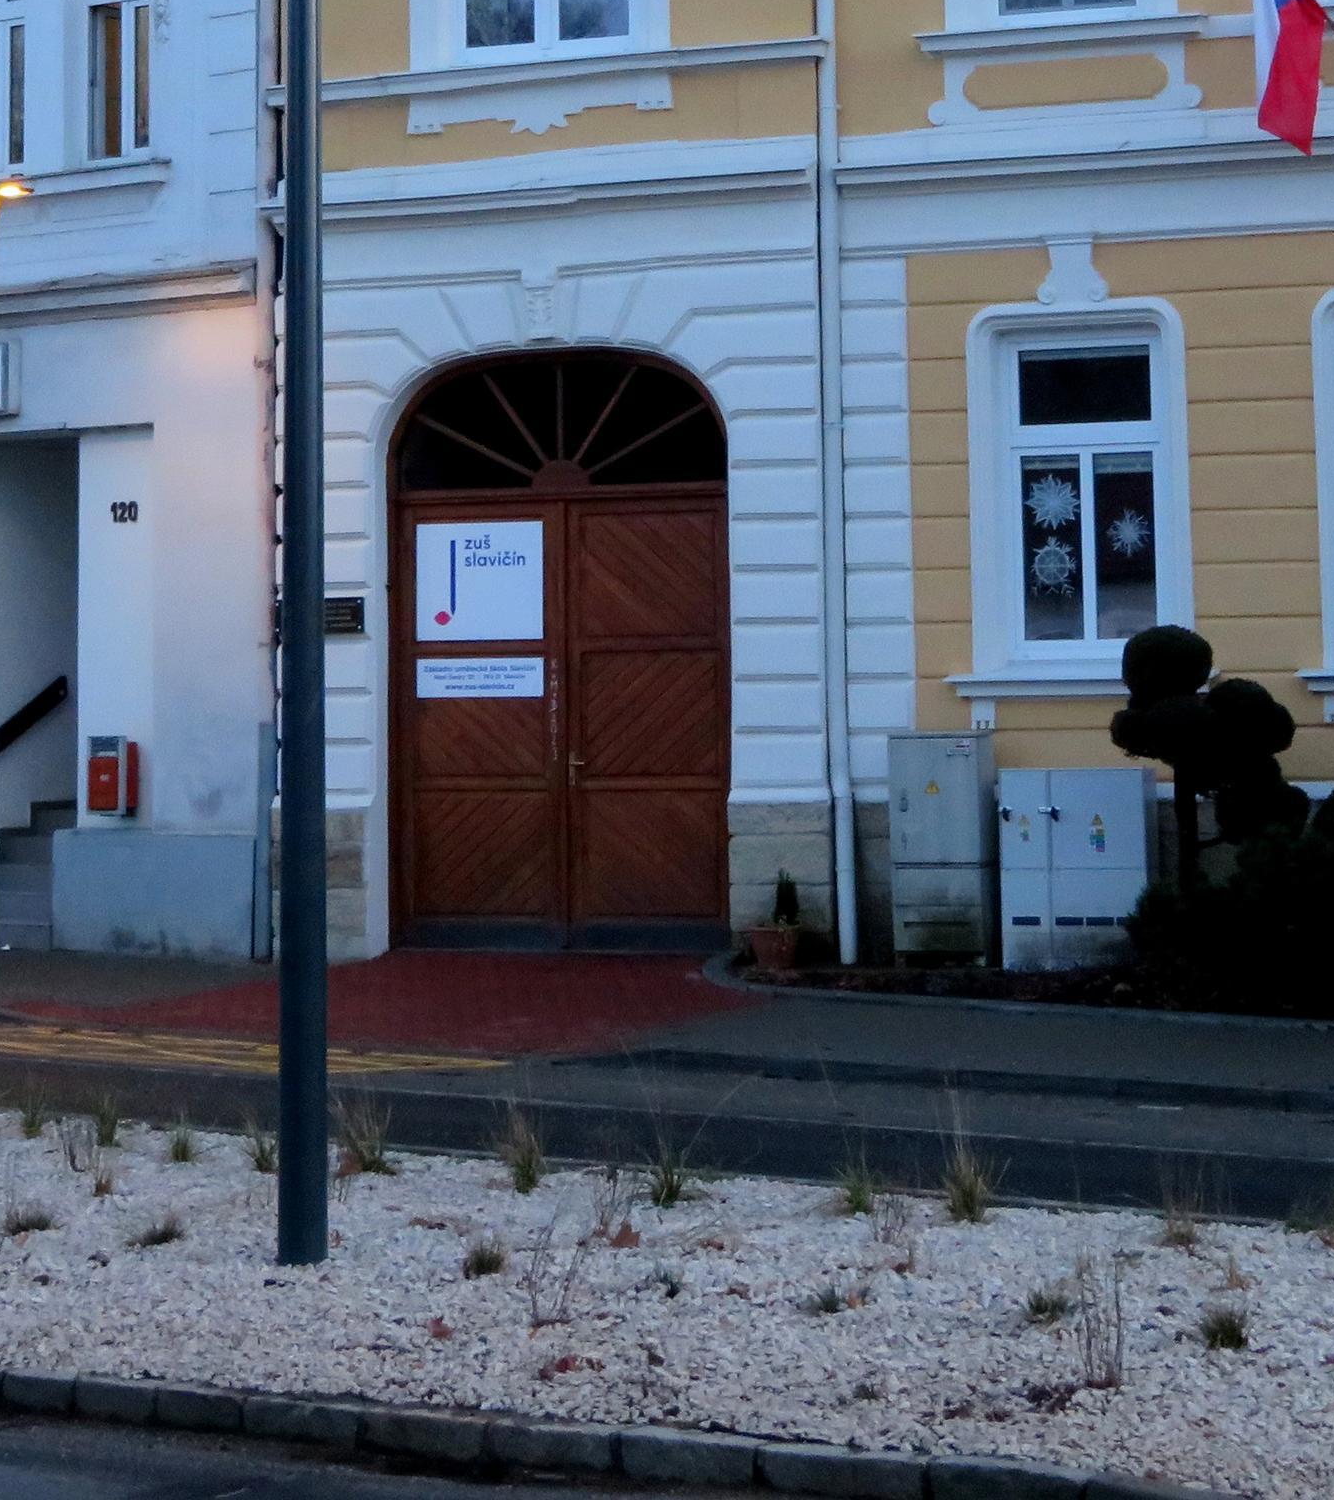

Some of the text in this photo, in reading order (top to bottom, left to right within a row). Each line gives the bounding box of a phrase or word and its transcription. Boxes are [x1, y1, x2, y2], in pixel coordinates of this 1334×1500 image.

[110, 500, 138, 523] 120
[464, 534, 491, 550] zuš
[464, 551, 526, 567] slavičín
